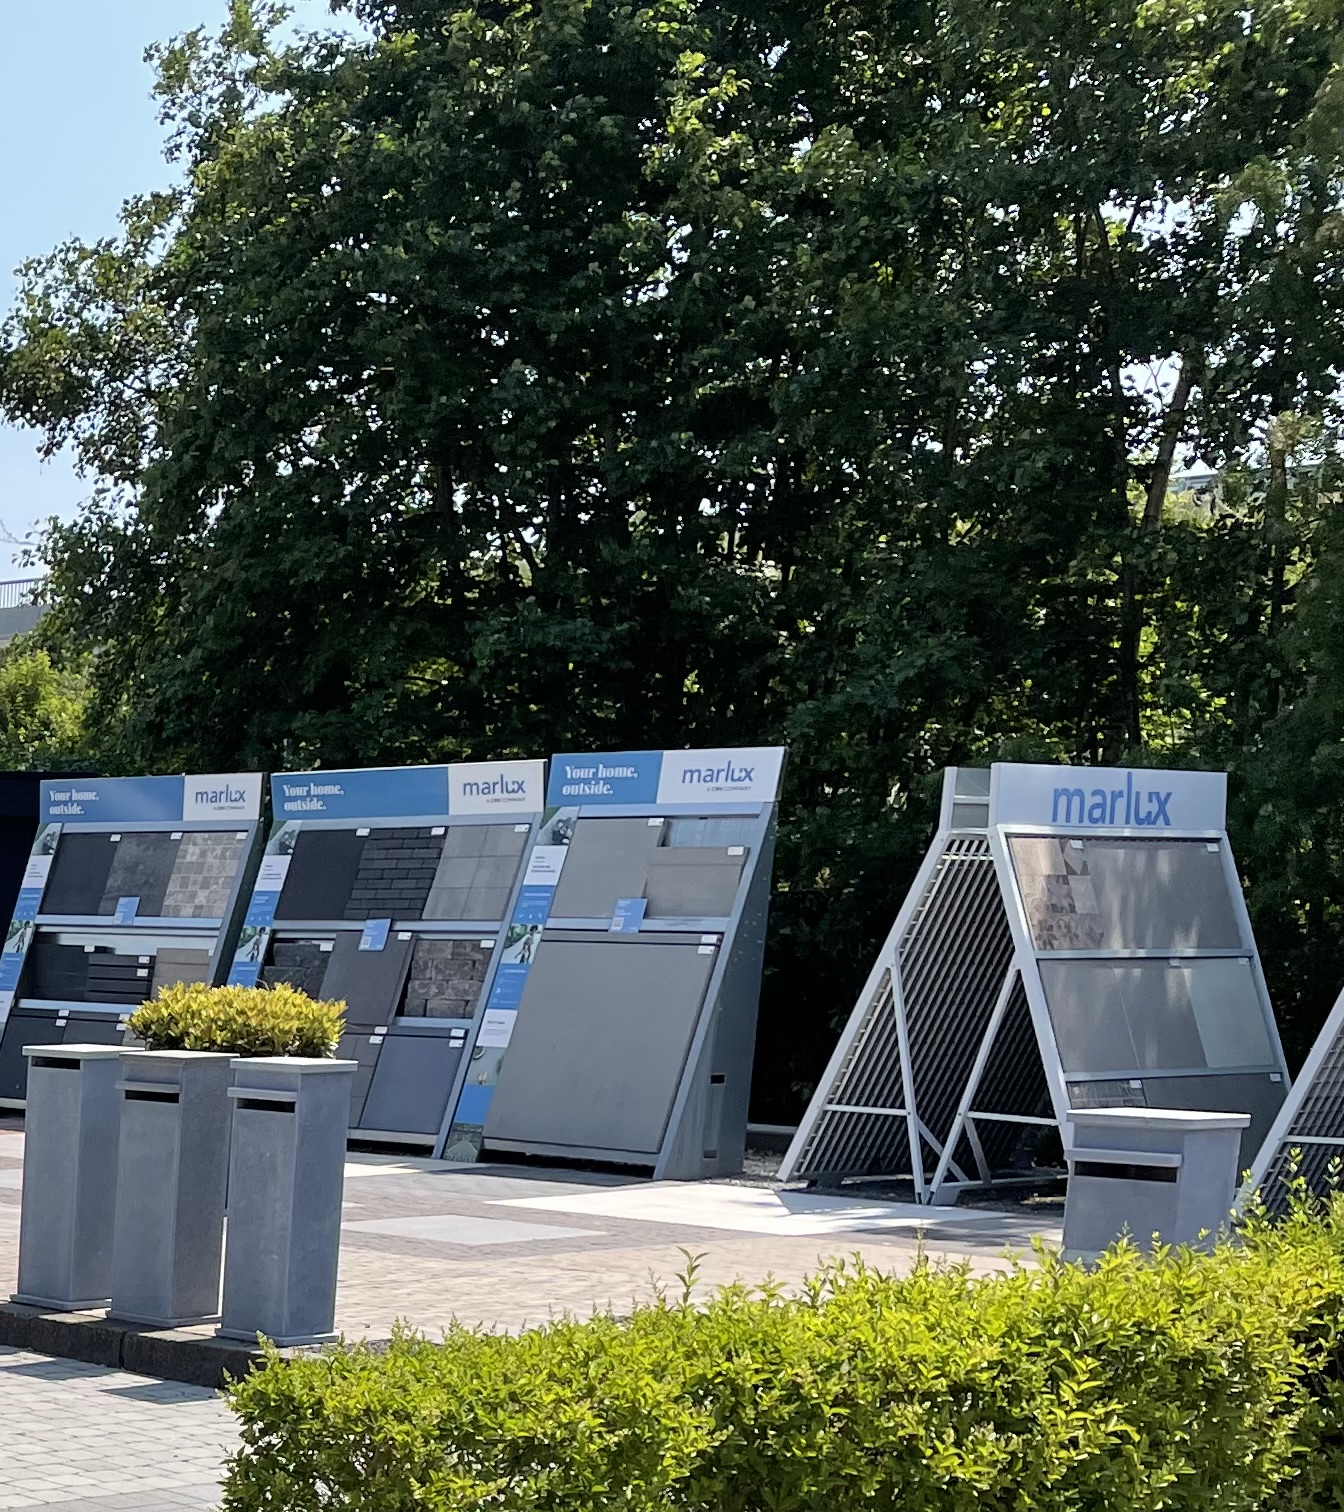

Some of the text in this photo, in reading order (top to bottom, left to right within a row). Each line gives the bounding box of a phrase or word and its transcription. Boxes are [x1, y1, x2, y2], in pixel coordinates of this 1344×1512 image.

[565, 763, 638, 779] Your home,
[681, 760, 755, 784] marlux
[282, 782, 345, 796] Your home,
[463, 773, 526, 797] marlux
[562, 780, 614, 796] outside.
[49, 788, 100, 801] Your home,
[195, 784, 246, 804] marlux
[1051, 771, 1172, 826] marlux
[49, 803, 85, 815] outside.
[283, 797, 327, 811] outside.
